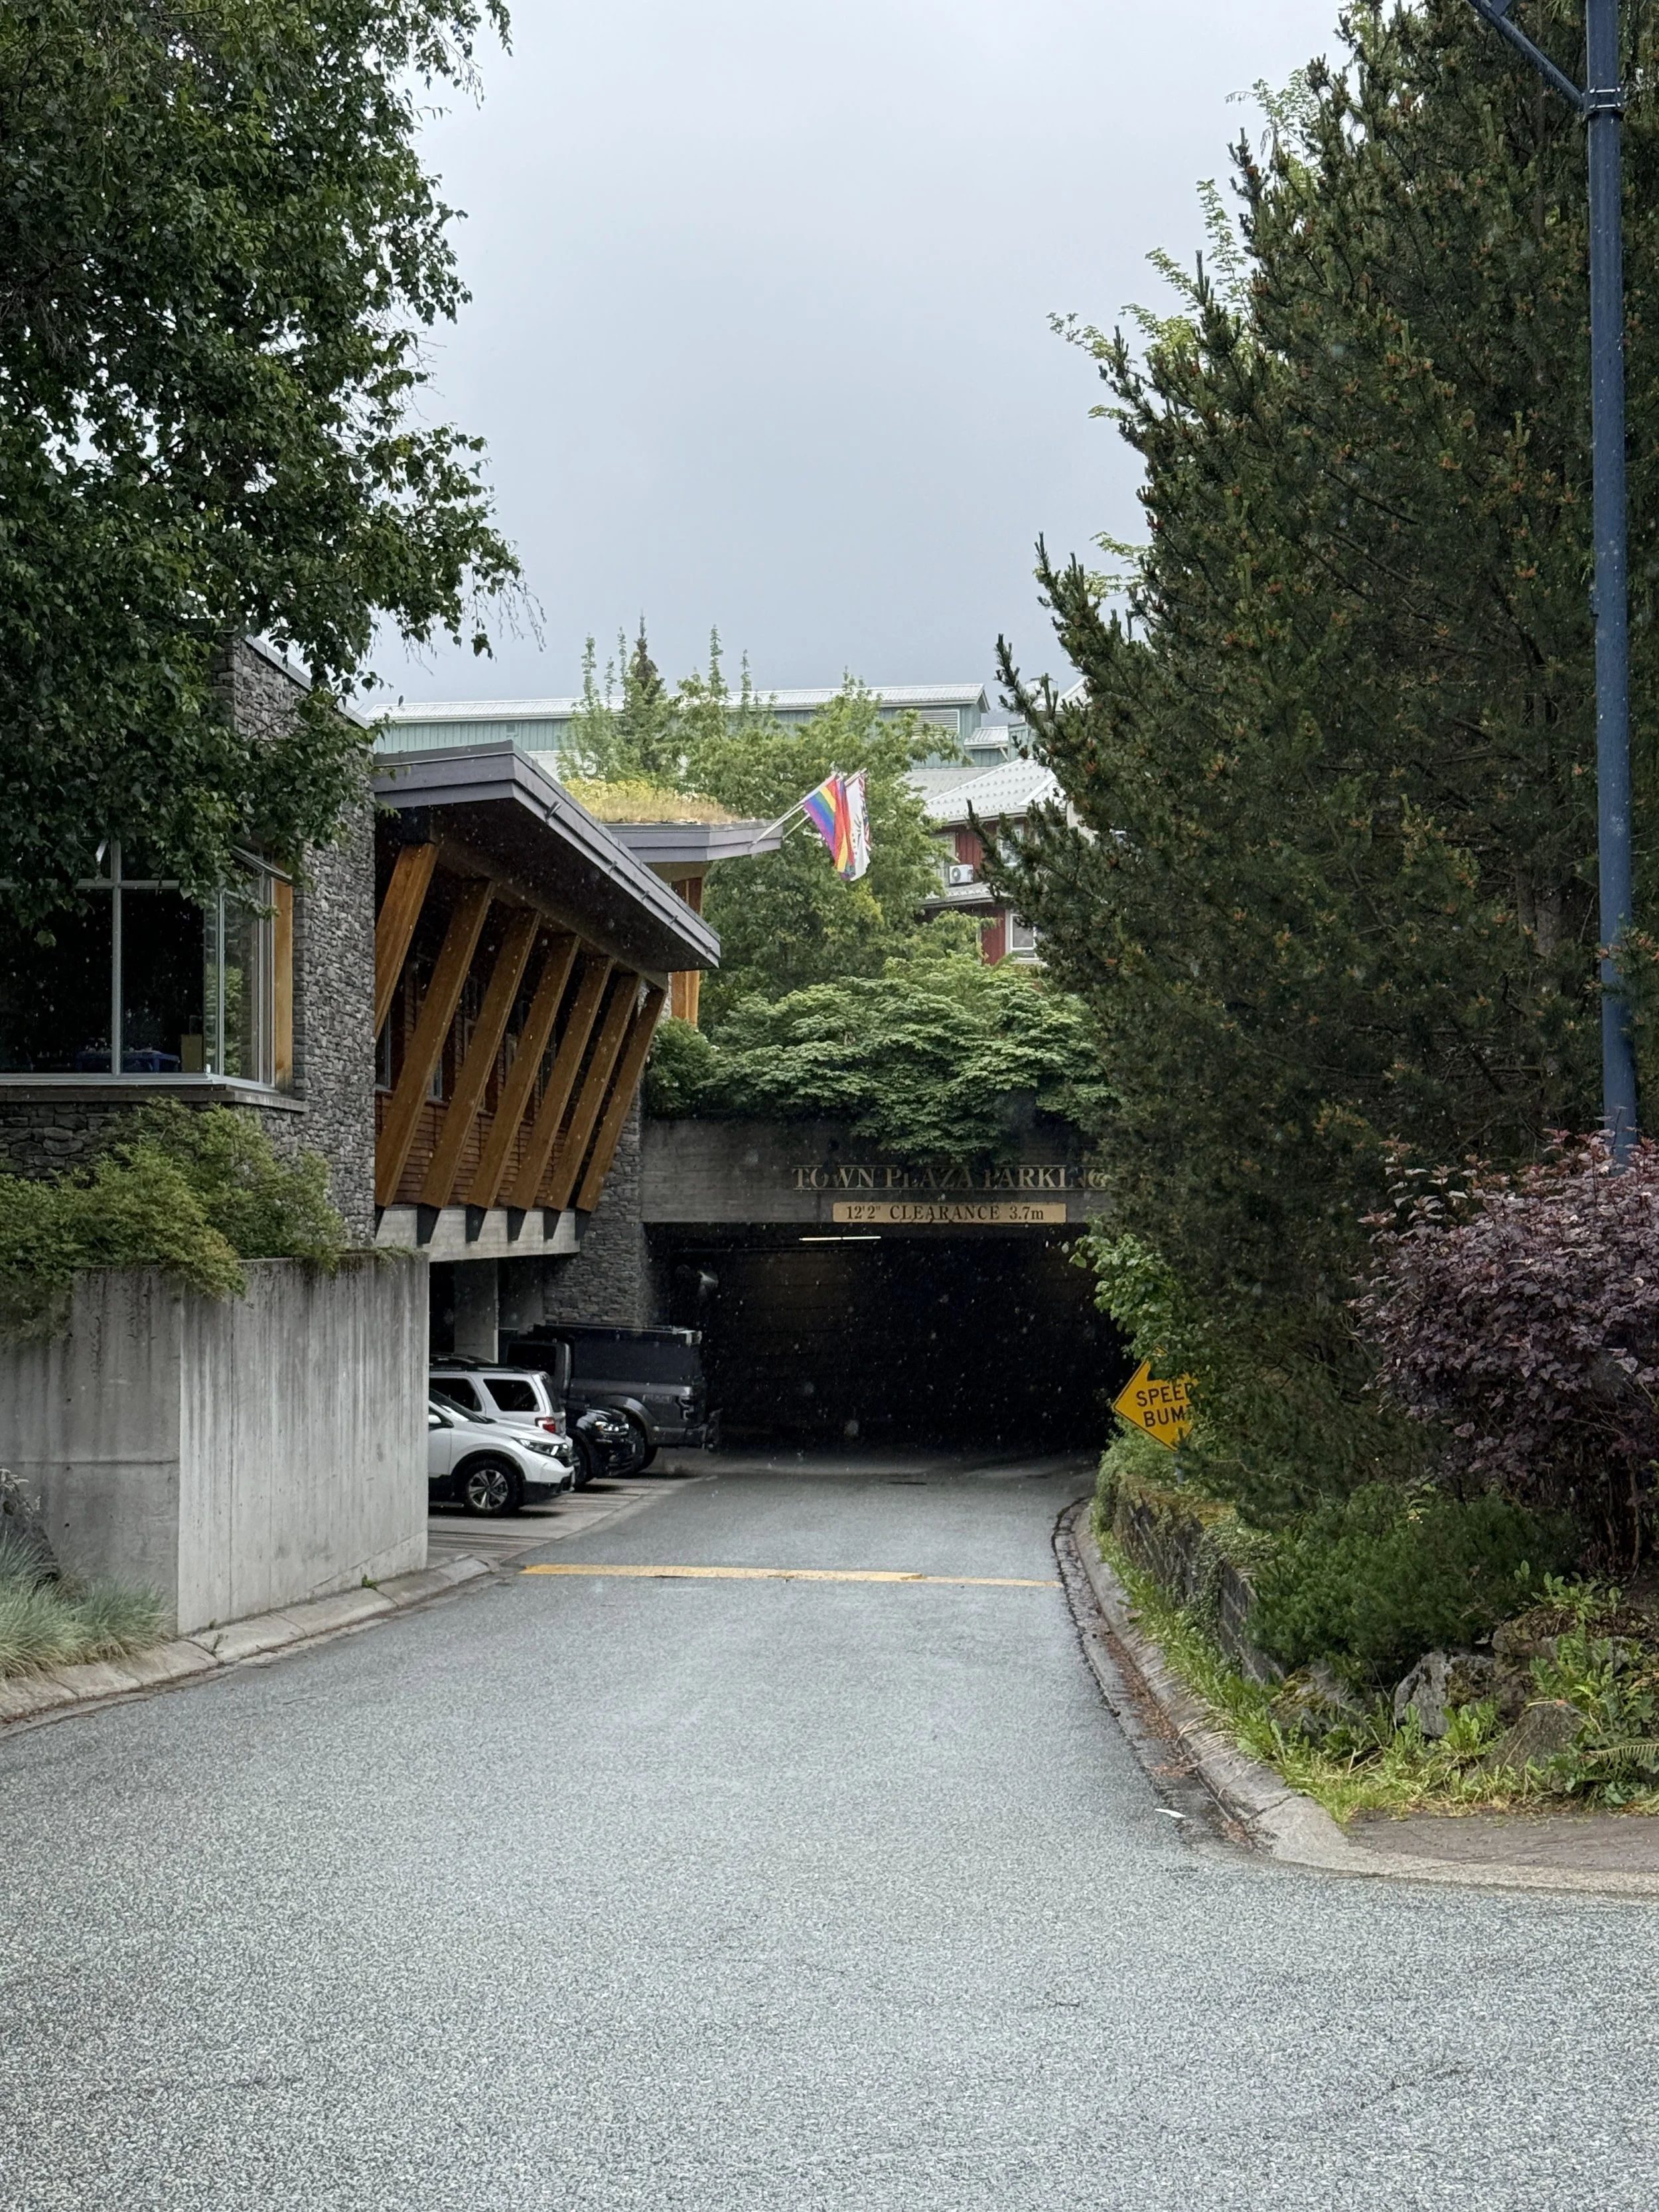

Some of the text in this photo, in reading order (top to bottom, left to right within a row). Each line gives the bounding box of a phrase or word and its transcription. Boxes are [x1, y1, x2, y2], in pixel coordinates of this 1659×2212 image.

[792, 1167, 875, 1188] TOWN
[846, 1205, 1044, 1220] 12'2" CLEARANCE 3.7m
[1143, 1404, 1192, 1427] BUM
